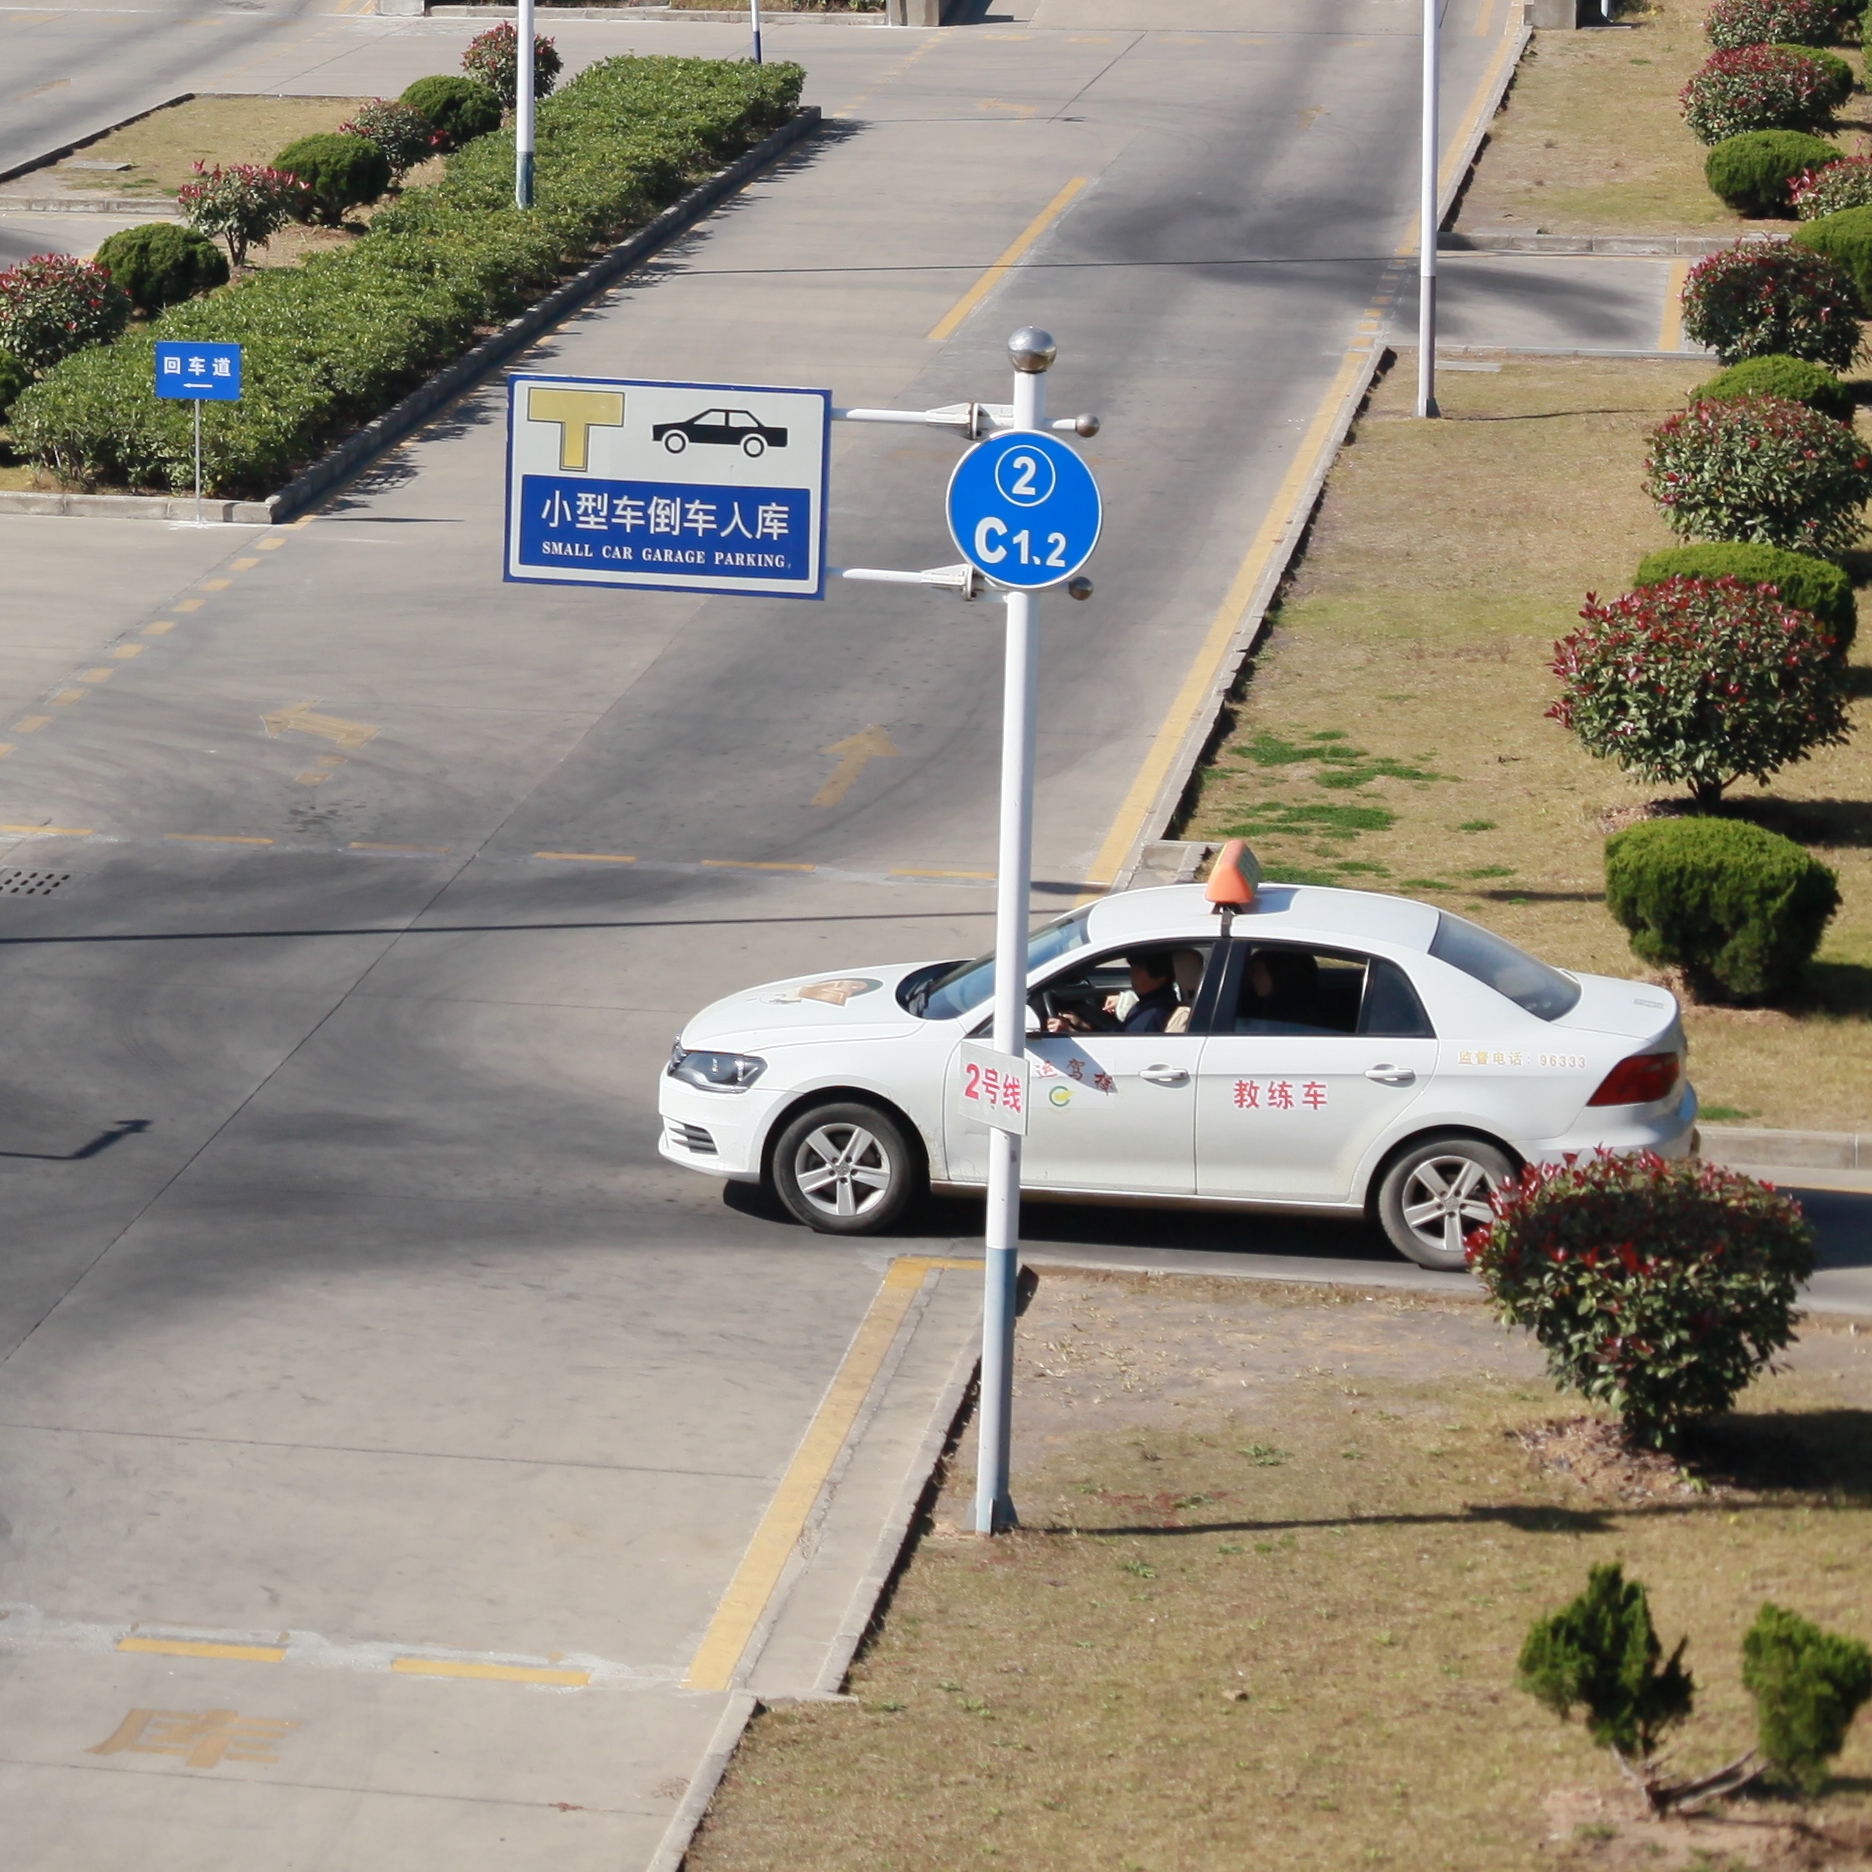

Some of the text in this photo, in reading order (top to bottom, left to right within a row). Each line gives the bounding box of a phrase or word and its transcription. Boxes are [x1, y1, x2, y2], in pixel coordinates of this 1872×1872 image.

[163, 355, 232, 377] 回车道
[540, 489, 790, 542] 小型车倒车入库
[542, 541, 786, 568] SMALL CAR GARAGE PARKING
[974, 516, 1067, 569] C1.2
[965, 1063, 1022, 1113] 2号线
[1233, 1079, 1328, 1110] 教练车
